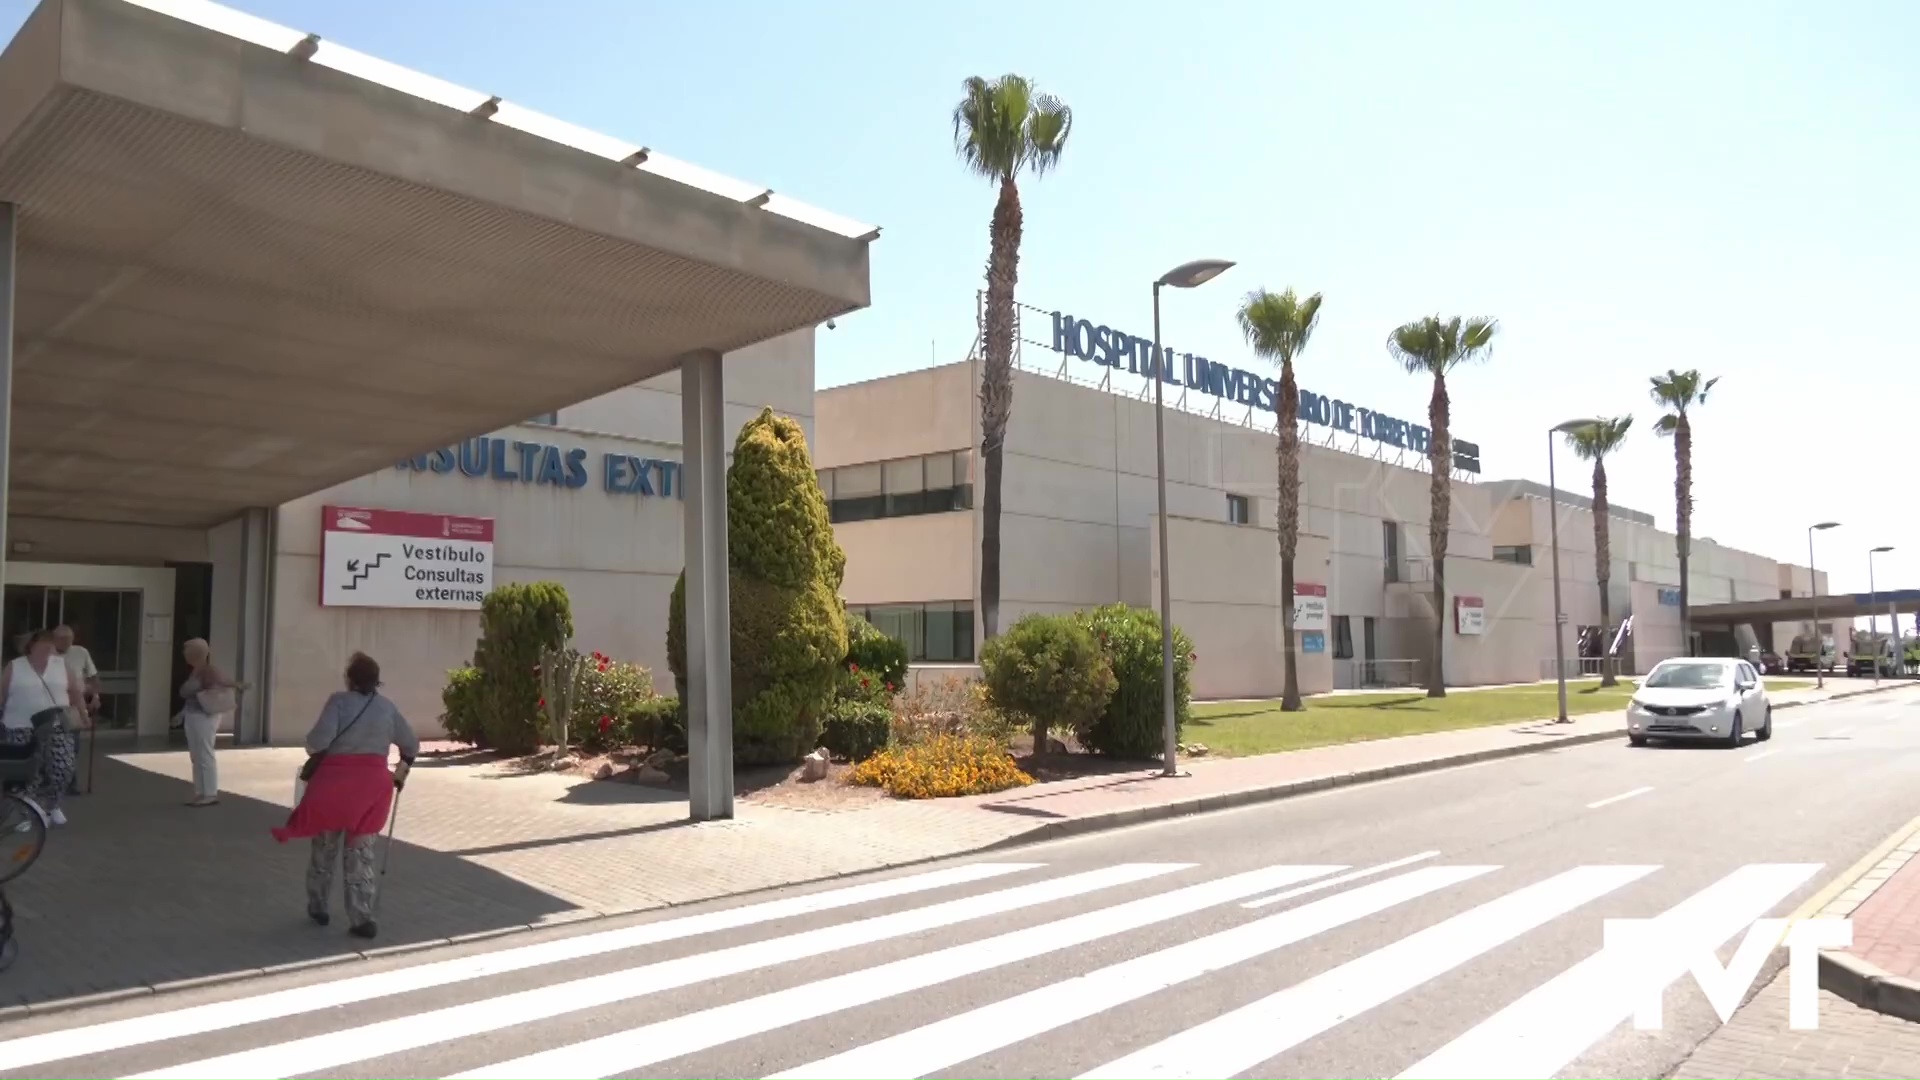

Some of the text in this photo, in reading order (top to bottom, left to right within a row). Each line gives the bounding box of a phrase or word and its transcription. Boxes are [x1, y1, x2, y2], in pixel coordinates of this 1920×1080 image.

[1052, 310, 1181, 386] HOSPITAL
[1332, 399, 1355, 434] DE
[604, 453, 684, 499] EXT
[402, 543, 485, 563] Vestíbulo
[404, 565, 484, 584] Consultas
[416, 586, 484, 602] externas
